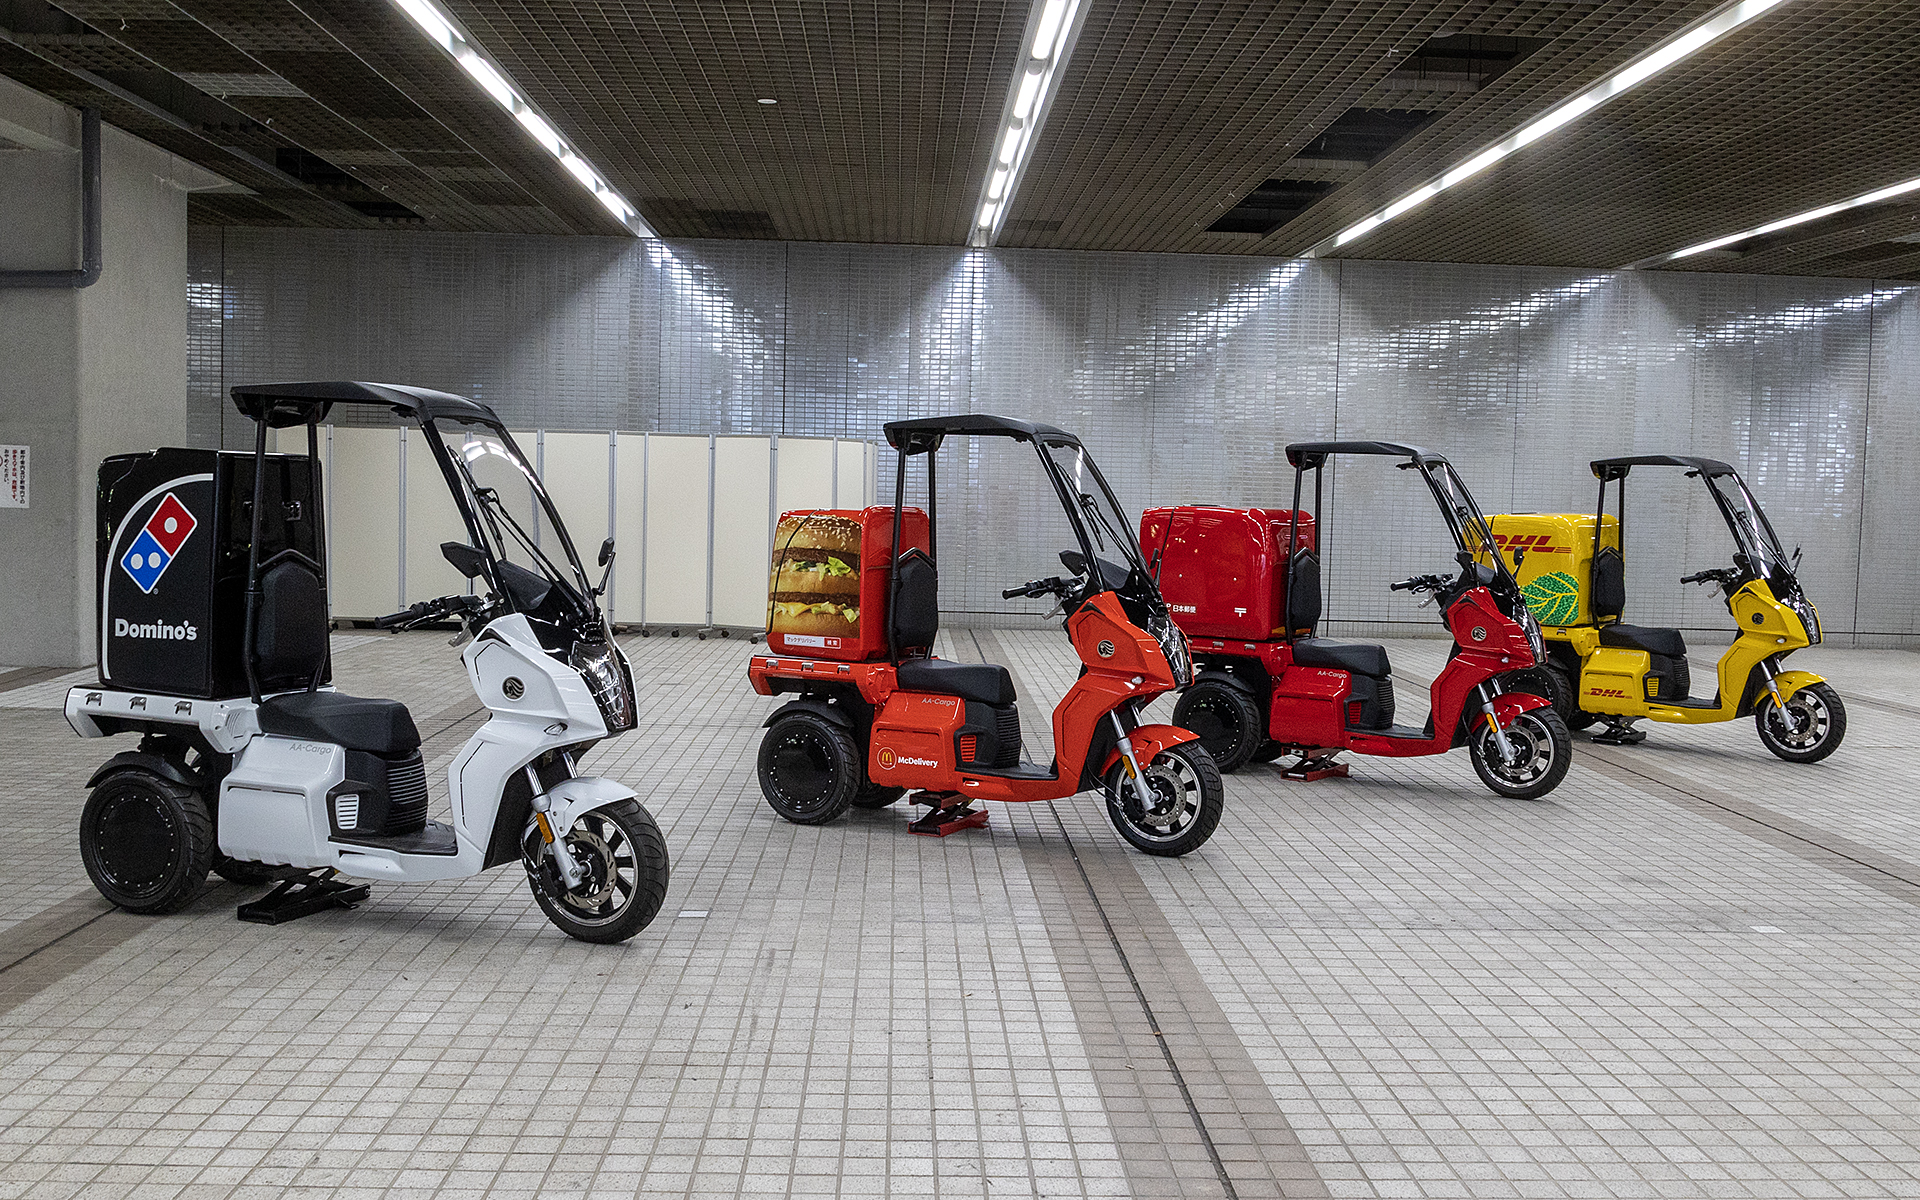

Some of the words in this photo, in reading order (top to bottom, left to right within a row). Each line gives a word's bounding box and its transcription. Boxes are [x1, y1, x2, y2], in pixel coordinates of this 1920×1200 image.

[1590, 687, 1625, 698] DHL
[921, 697, 955, 706] AA-Cargo
[289, 743, 332, 755] AA-Cargo
[897, 756, 939, 769] McDelivery
